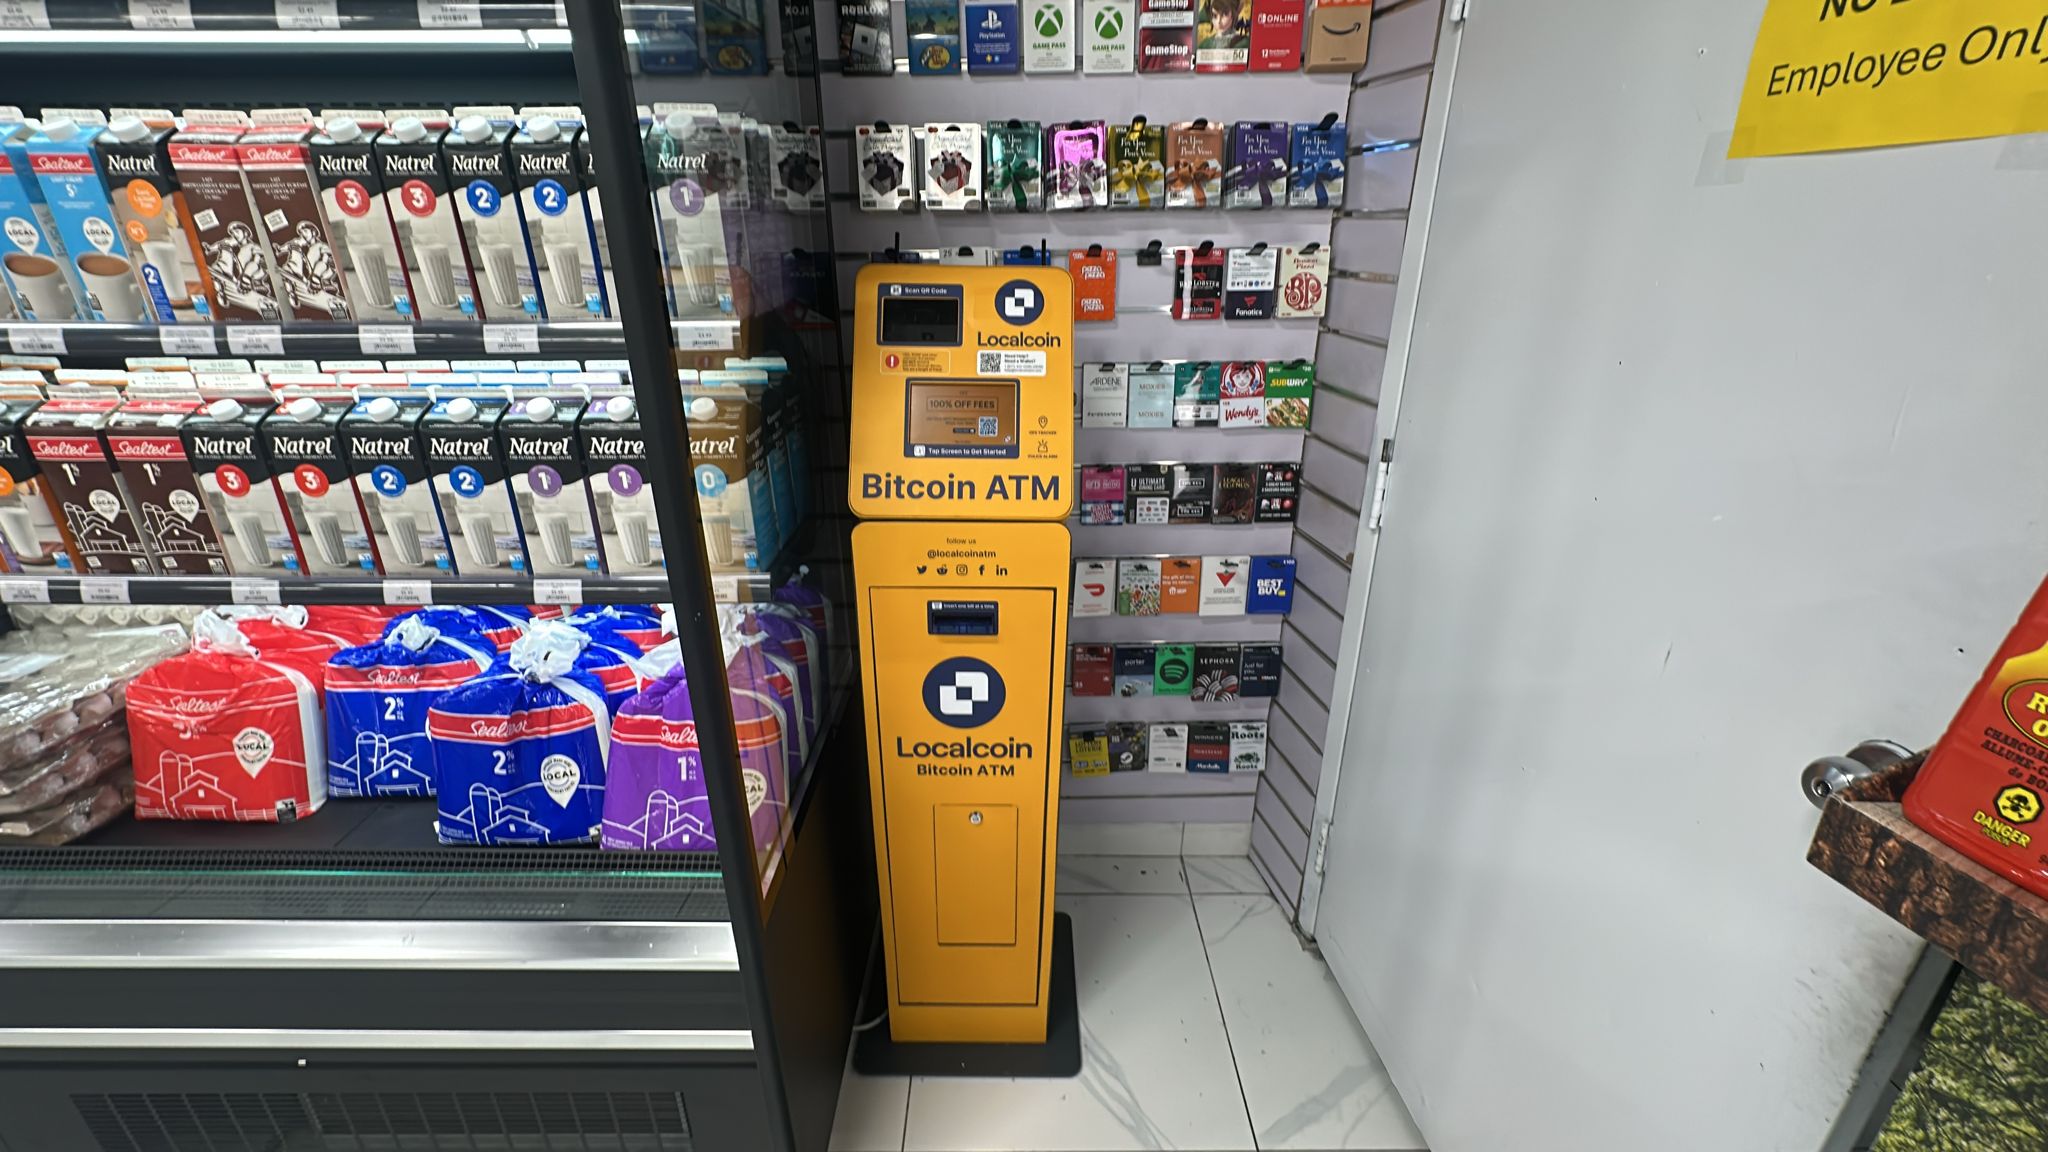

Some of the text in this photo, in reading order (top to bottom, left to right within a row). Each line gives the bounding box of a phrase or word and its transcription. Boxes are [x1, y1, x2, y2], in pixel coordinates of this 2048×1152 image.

[842, 7, 884, 16] ROBLOX
[1267, 14, 1299, 23] ONLINE
[1033, 41, 1066, 50] GAME PASS
[1111, 43, 1126, 51] PASS
[1145, 45, 1188, 56] GameStop
[1233, 50, 1245, 60] 50
[1767, 15, 2048, 97] Employee Onl
[1133, 137, 1146, 150] You
[1190, 135, 1204, 148] You
[1256, 133, 1269, 147] You
[1313, 135, 1327, 148] You
[178, 147, 225, 162] Sealtest
[247, 147, 293, 162] Sealtest
[452, 153, 501, 170] Natrel
[520, 153, 568, 170] Natrel
[657, 151, 706, 169] Natrel
[38, 156, 84, 170] Sealtest
[107, 154, 156, 172] Natrel
[319, 154, 368, 171] Natrel
[386, 154, 435, 171] Natrel
[1082, 265, 1103, 276] pizza
[1085, 271, 1107, 281] pizza
[1193, 279, 1220, 289] LOBSTER
[1081, 297, 1102, 308] pizza
[1083, 304, 1105, 314] pizza
[1236, 308, 1262, 317] Fanatics
[978, 332, 1061, 347] Localcoin
[1090, 376, 1121, 386] ARDENE
[1270, 379, 1308, 387] SUBWAY
[930, 400, 995, 409] 100% OFF FEES
[1225, 407, 1259, 421] Wendy's
[37, 441, 89, 456] Sealtest
[118, 441, 171, 456] Sealtest
[194, 436, 252, 454] Natrel
[273, 436, 332, 454] Natrel
[351, 436, 410, 455] Natrel
[430, 437, 489, 455] Natrel
[509, 437, 568, 455] Natrel
[589, 436, 646, 454] Natre
[690, 436, 735, 454] atrel
[929, 448, 940, 456] Tap
[862, 473, 1060, 500] Bitcoin ATM
[1138, 478, 1165, 486] ULTIMATE
[927, 550, 997, 559] @localcoinatm
[1257, 579, 1283, 588] BEST
[1258, 587, 1279, 596] BUY
[1125, 658, 1145, 666] porter
[368, 669, 420, 685] Sealtest
[170, 695, 226, 712] Sealtest
[471, 719, 529, 738] Sealtest
[661, 725, 698, 744] Sealte
[1231, 732, 1264, 740] Roots
[236, 742, 270, 751] LOCAL
[896, 736, 1033, 758] Localcoin
[1984, 727, 2048, 763] CHARCOA
[1981, 740, 2048, 778] ALLUME-C
[543, 769, 577, 781] LOCAL
[917, 764, 1015, 776] Bitcoin ATM
[2026, 772, 2048, 793] BO
[1973, 810, 2031, 848] DANGER
